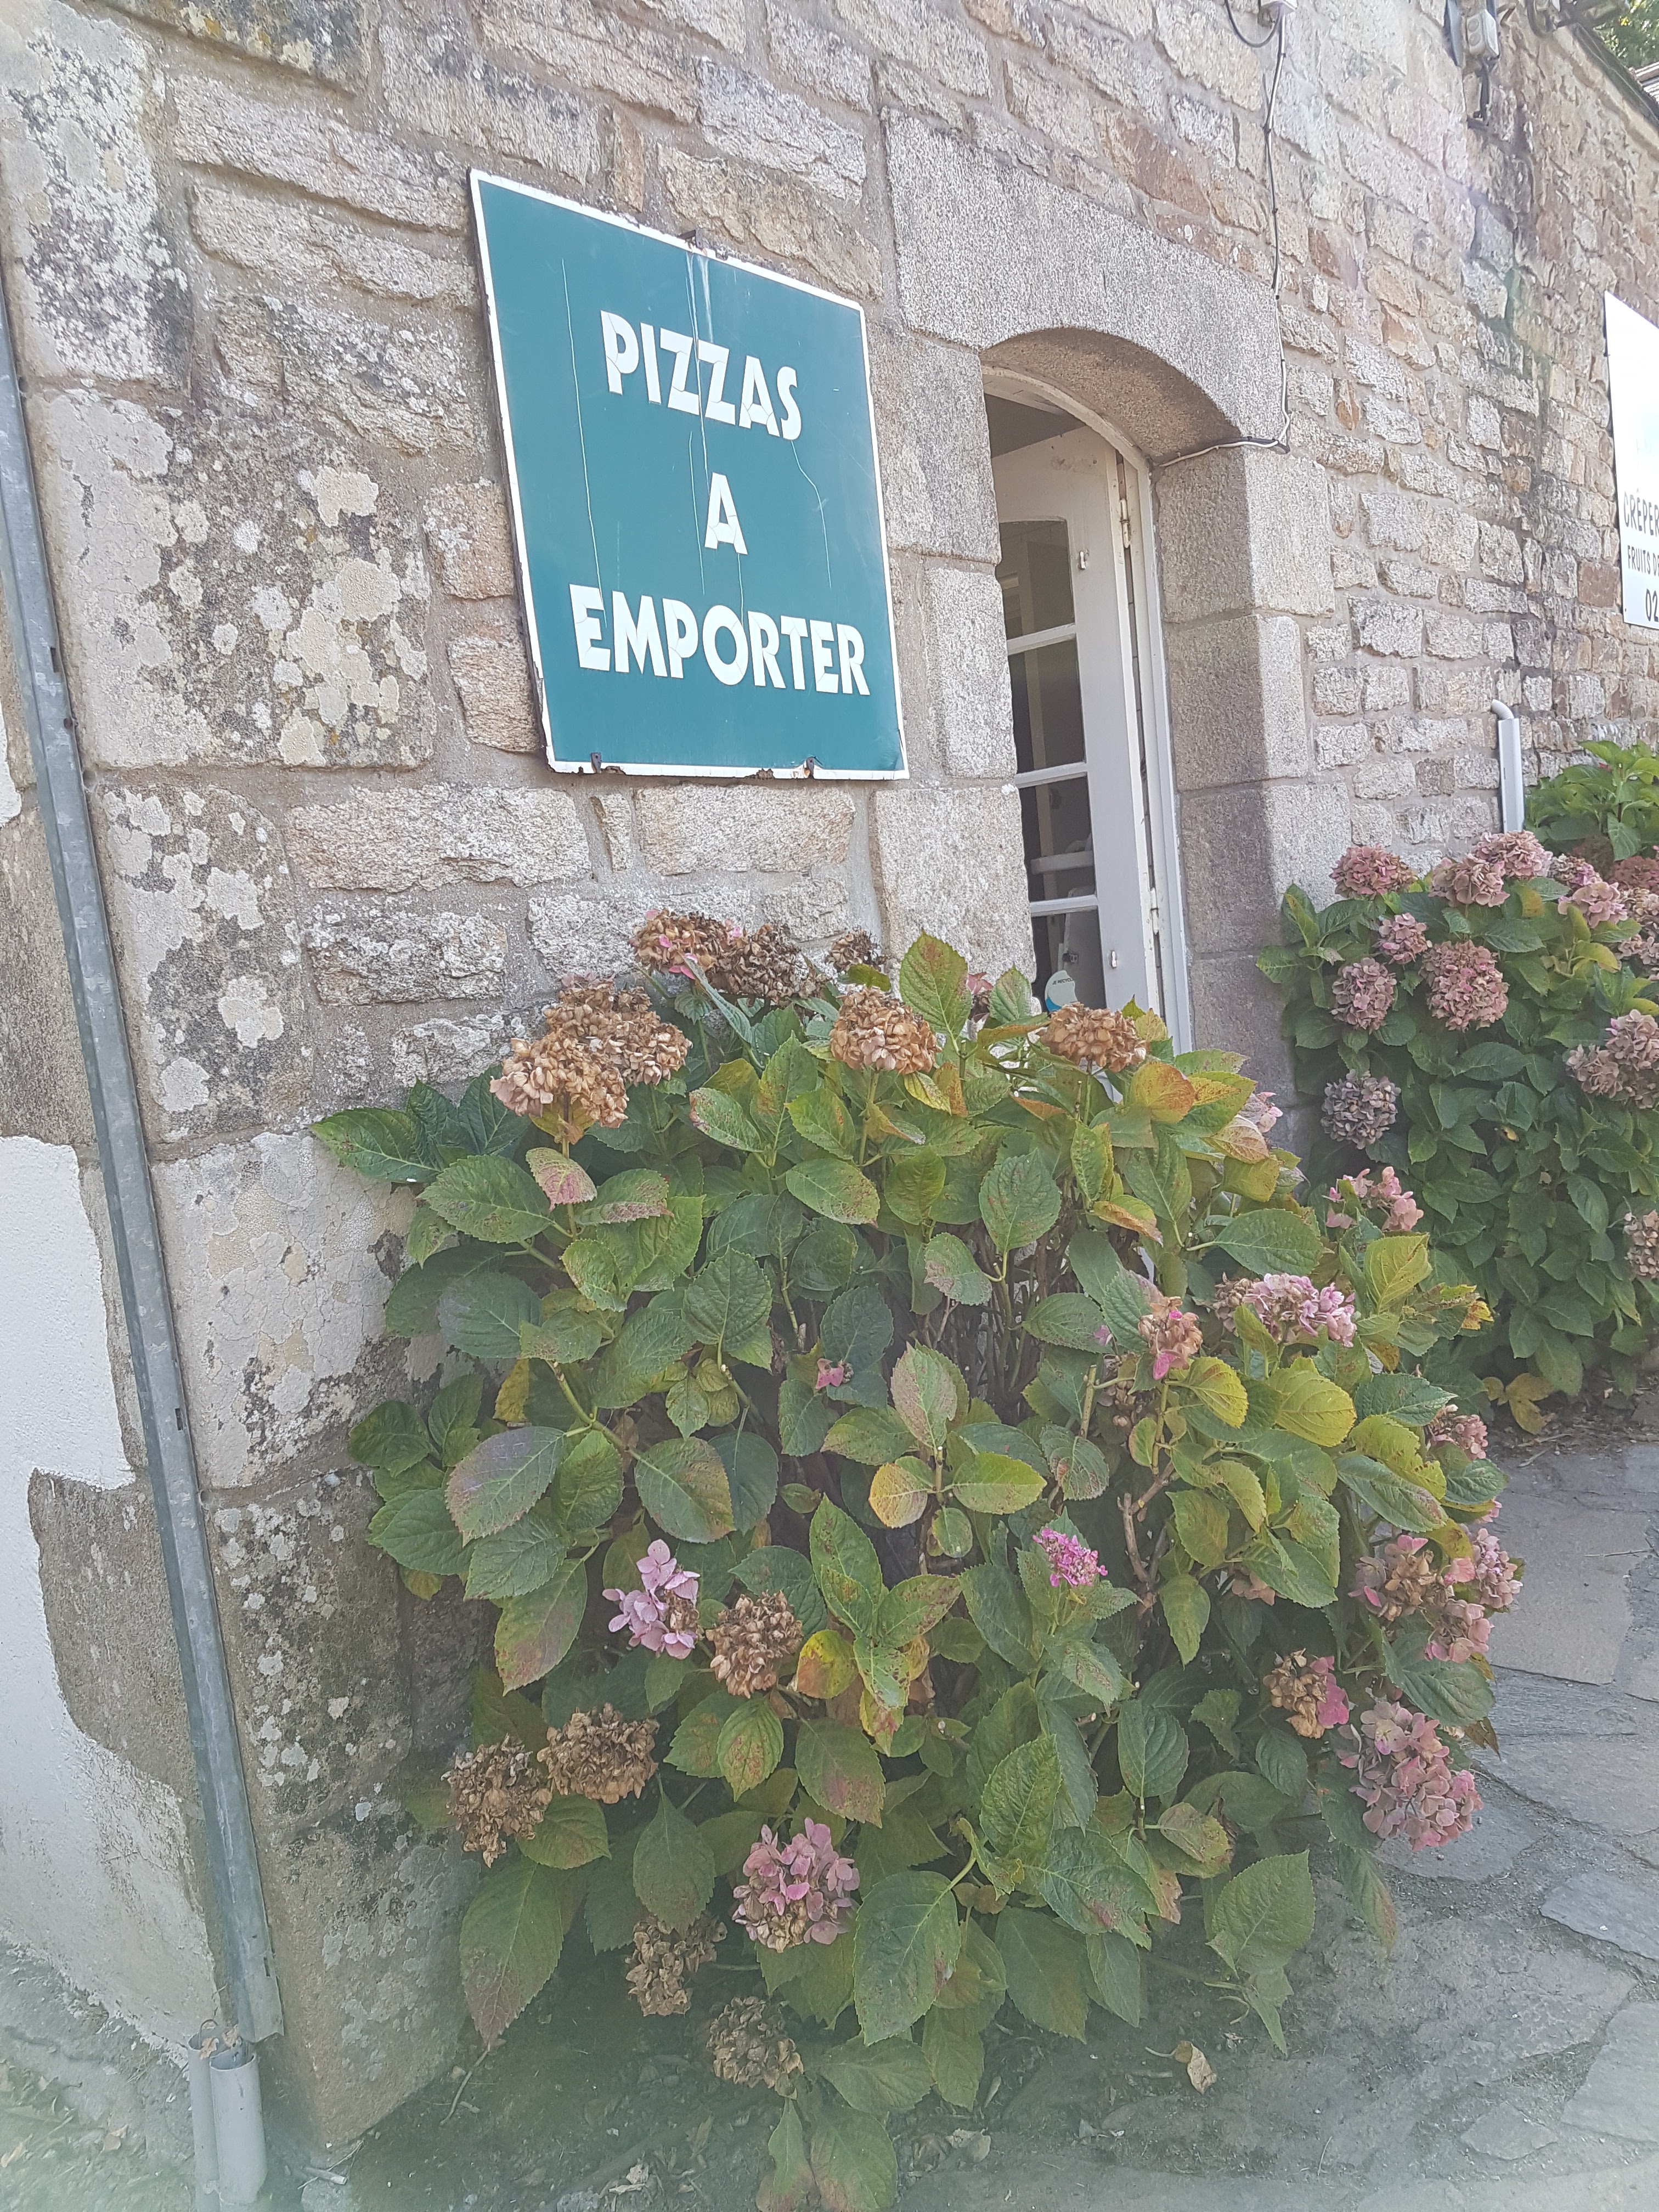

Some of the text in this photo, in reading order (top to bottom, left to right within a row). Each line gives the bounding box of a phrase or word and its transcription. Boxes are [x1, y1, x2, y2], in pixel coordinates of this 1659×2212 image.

[601, 311, 802, 440] PIZZAS
[704, 472, 748, 555] A
[1627, 545, 1651, 574] FRUITS
[569, 584, 870, 696] EMPORTER
[1646, 588, 1659, 622] 02
